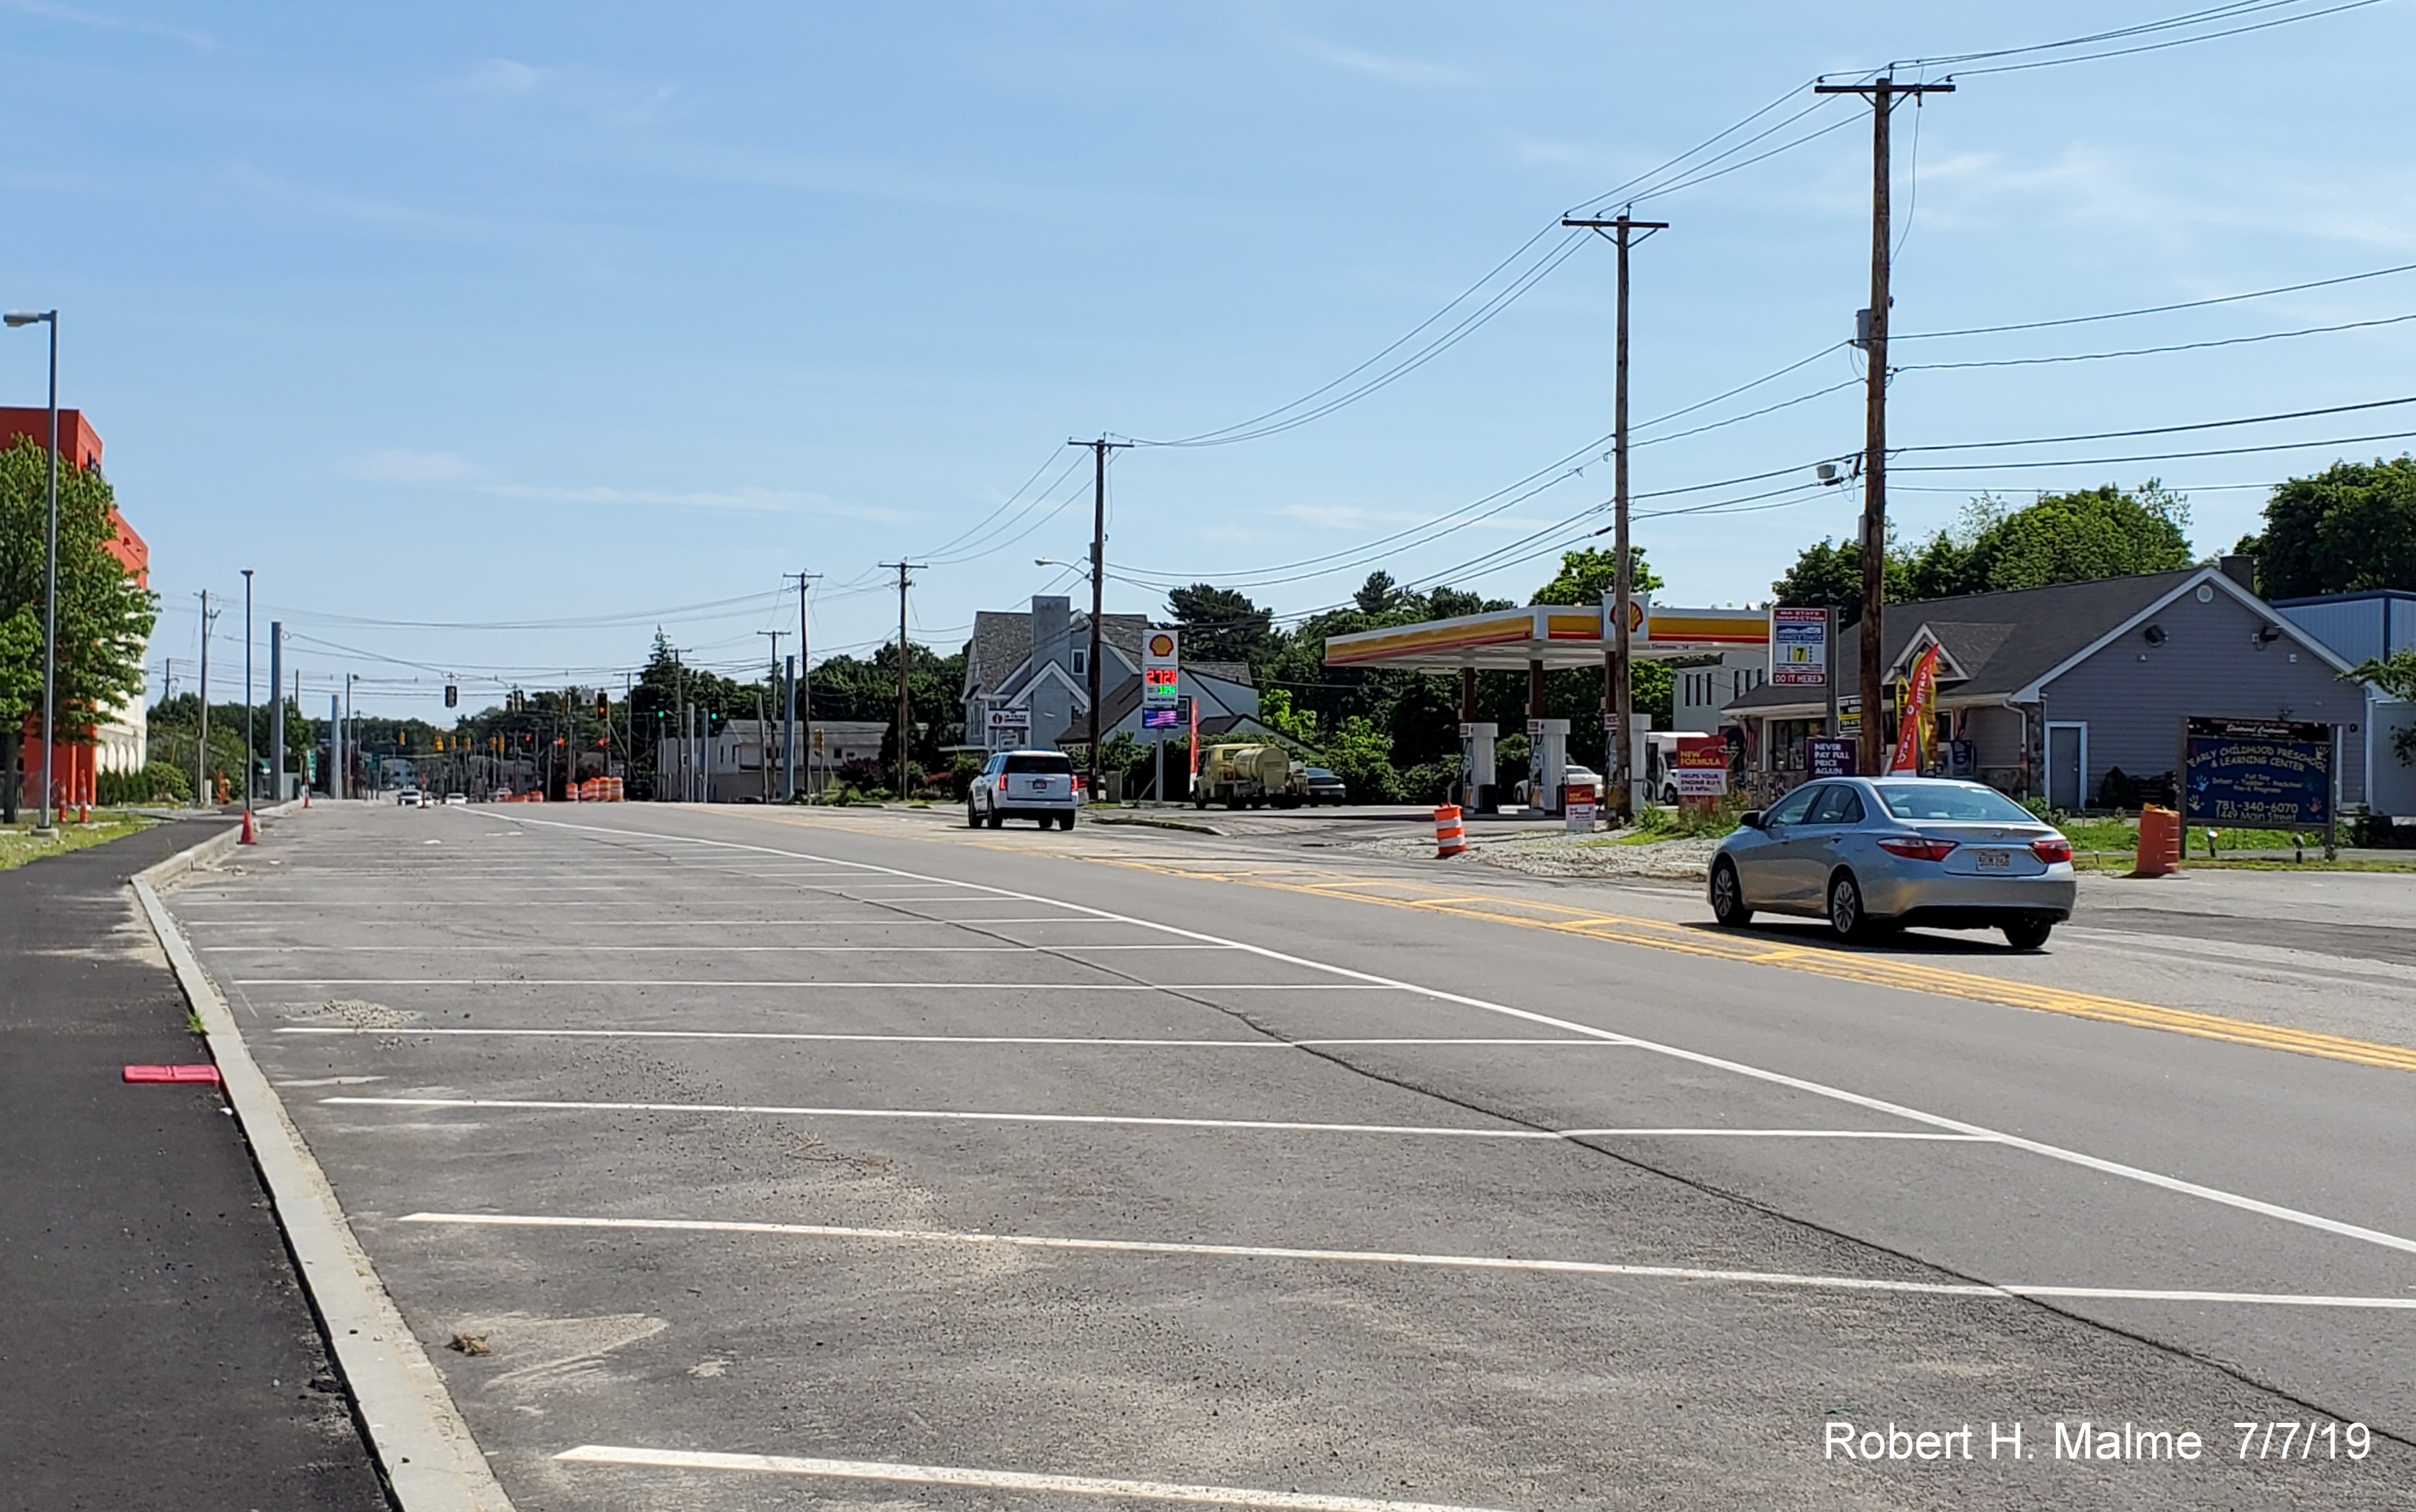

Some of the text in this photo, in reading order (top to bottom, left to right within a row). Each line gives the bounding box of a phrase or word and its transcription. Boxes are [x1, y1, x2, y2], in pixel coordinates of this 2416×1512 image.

[1796, 647, 1804, 661] 7
[1775, 674, 1786, 683] DO
[1796, 675, 1818, 683] HERE
[1680, 757, 1721, 766] FORMULA
[2187, 745, 2328, 774] EARLY CHILDHOOD PRESCHOOL
[2220, 756, 2268, 767] LEARNING
[2269, 757, 2305, 773] CENTER
[2215, 800, 2299, 813] 781-340-6070
[2240, 811, 2266, 821] Main
